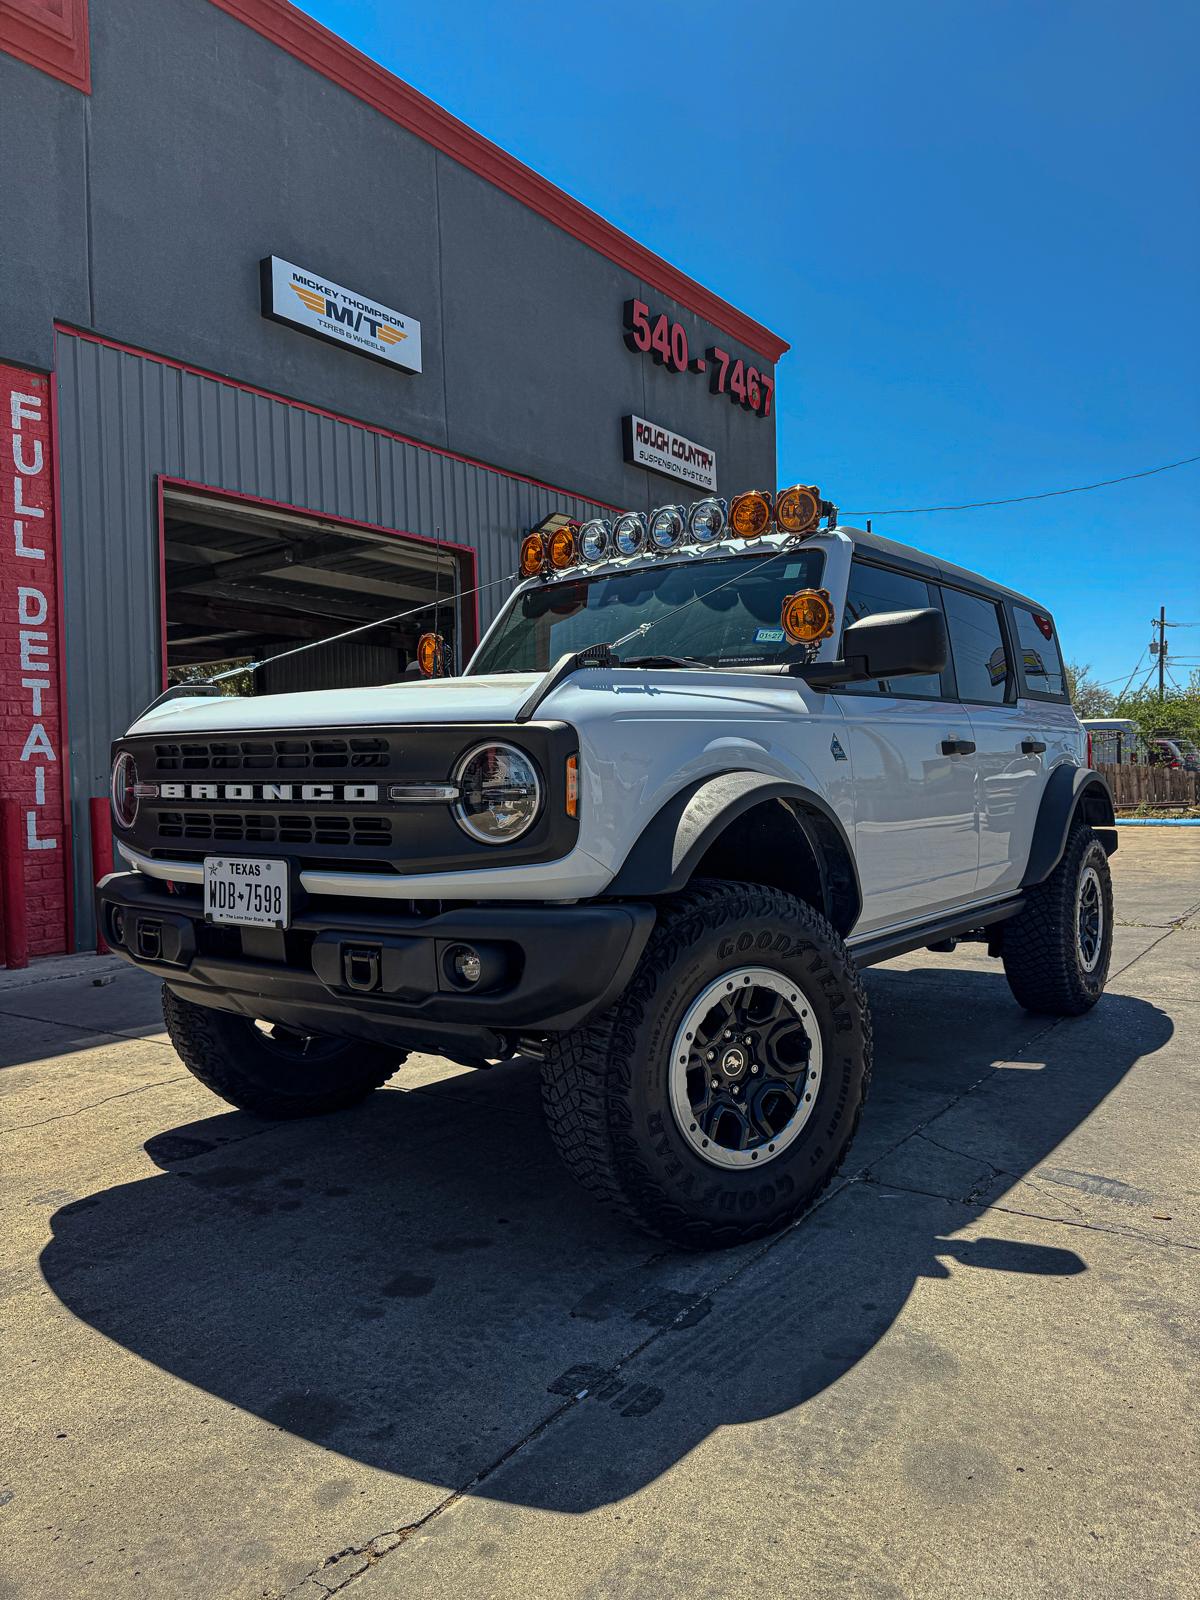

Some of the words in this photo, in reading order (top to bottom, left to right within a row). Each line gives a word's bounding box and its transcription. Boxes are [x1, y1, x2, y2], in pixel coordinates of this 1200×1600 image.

[292, 272, 339, 298] MICKEY
[340, 294, 405, 329] THOMPSON
[325, 298, 383, 338] M/T
[316, 318, 345, 336] TIRES
[345, 331, 353, 339] &
[353, 334, 386, 353] WHEELS
[636, 422, 670, 454] ROUGH
[671, 438, 713, 472] COUNTRY
[10, 390, 46, 560] FULL
[639, 450, 682, 473] SUSPENSION
[682, 467, 712, 486] SYSTEMS
[17, 586, 57, 850] DETAIL
[160, 783, 379, 802] BRONCO
[229, 862, 261, 877] TEXAS
